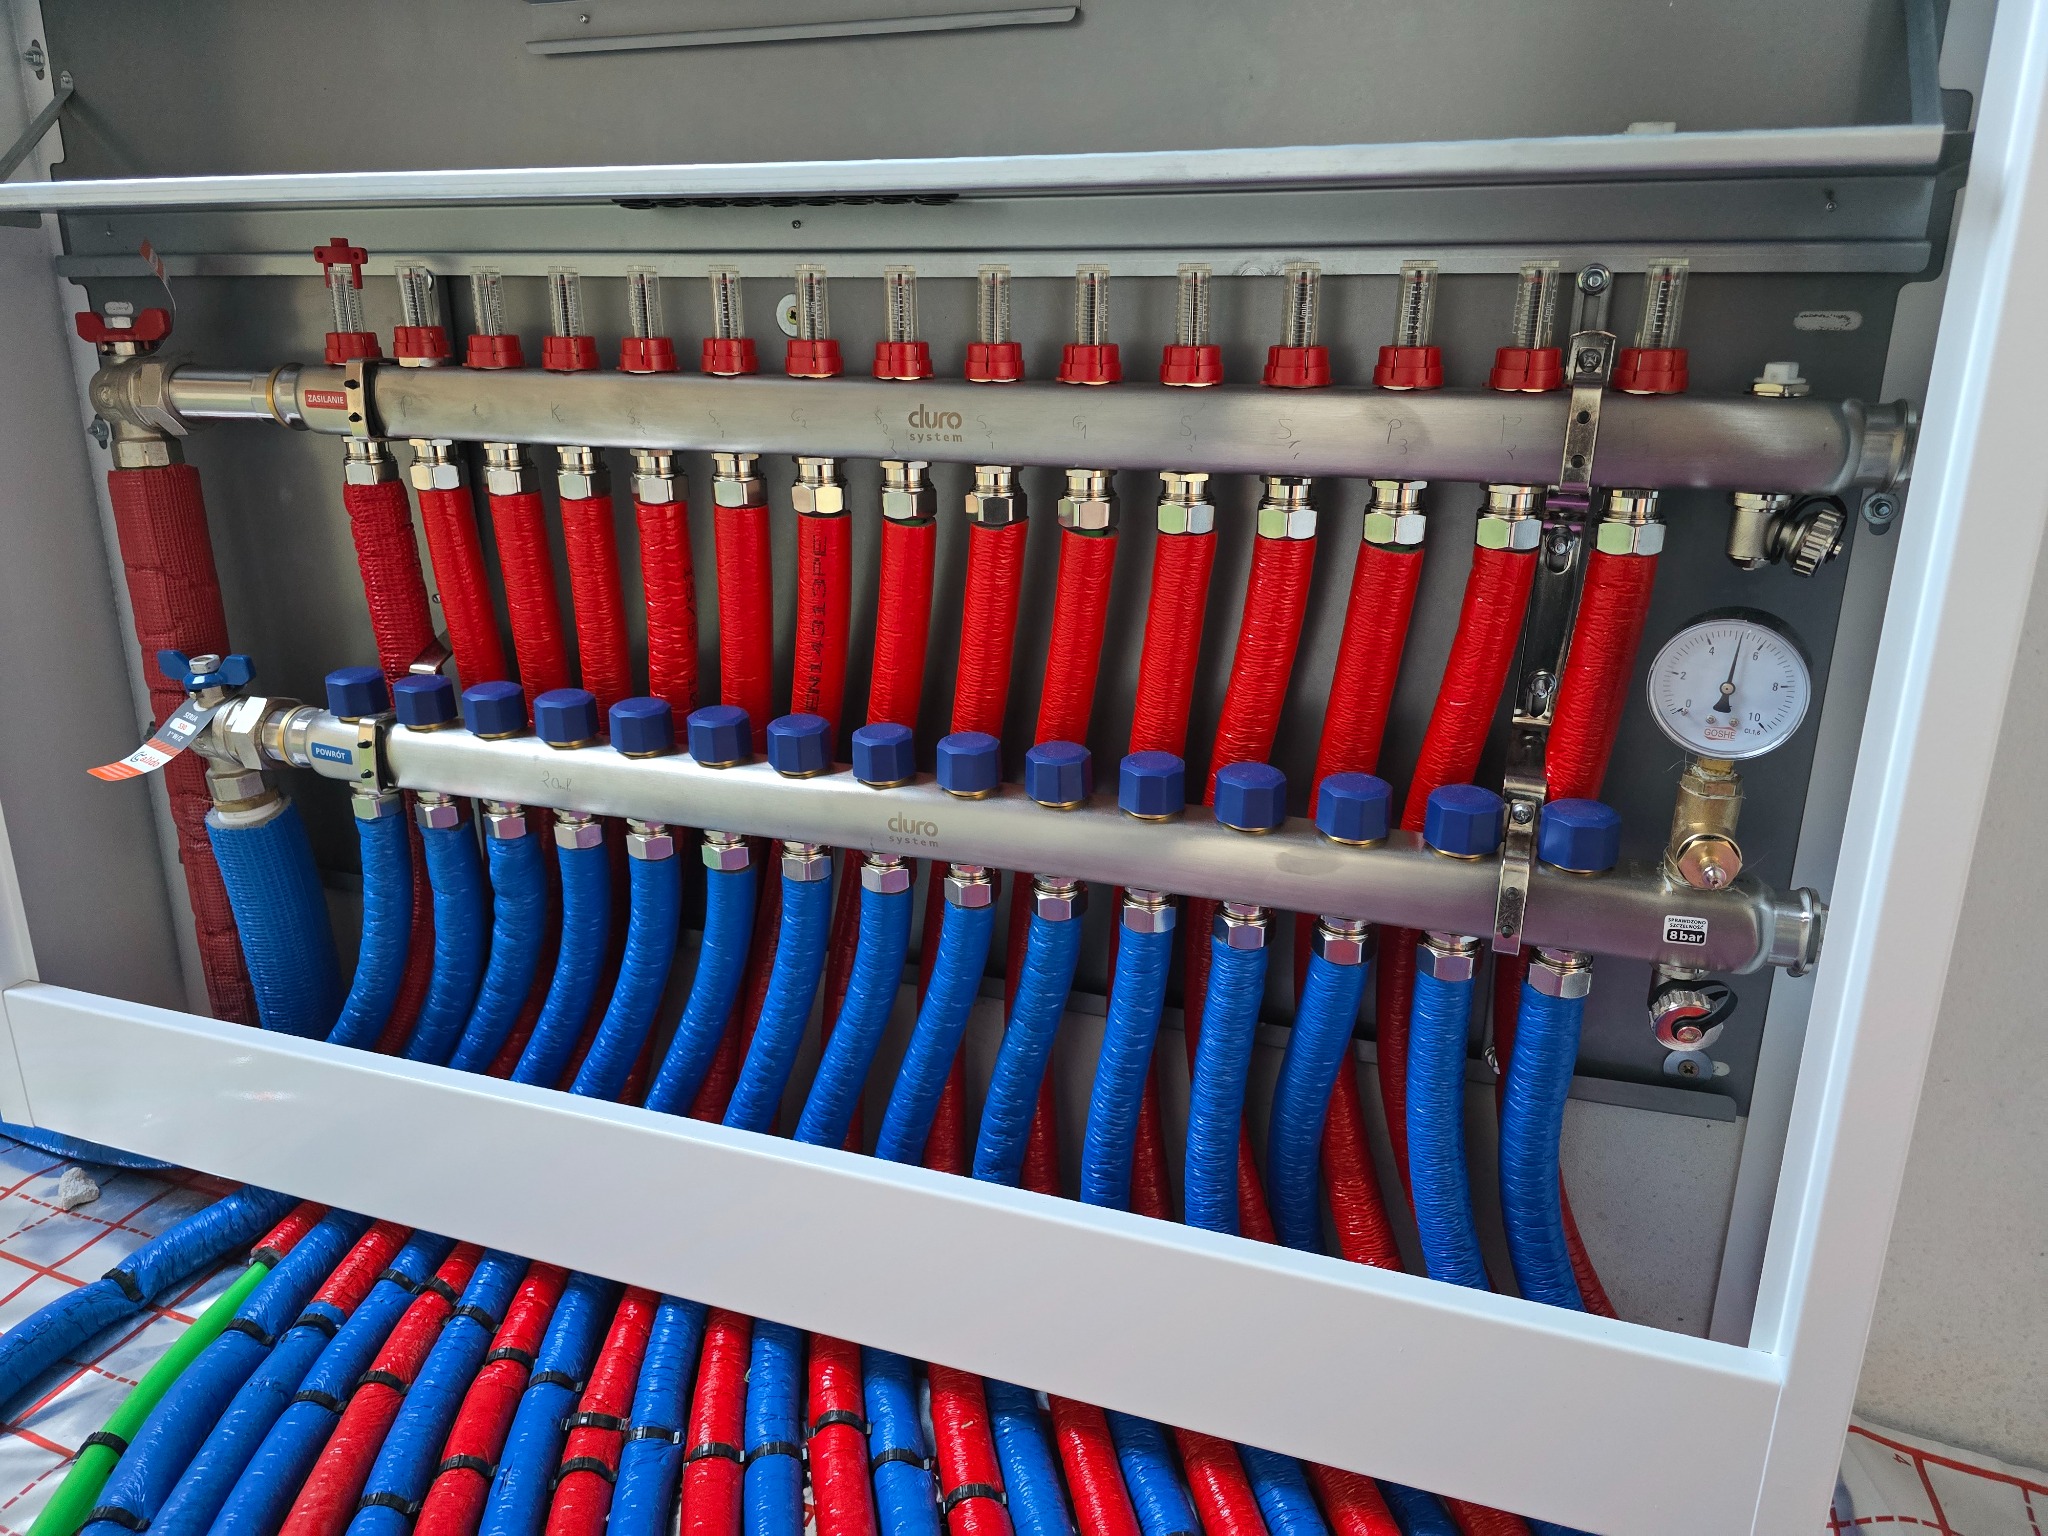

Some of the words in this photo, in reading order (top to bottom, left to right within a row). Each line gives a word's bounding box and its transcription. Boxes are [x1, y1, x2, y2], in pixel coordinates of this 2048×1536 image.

[307, 394, 345, 405] ZASILANIE
[908, 403, 963, 430] duro
[909, 432, 963, 443] system
[1708, 646, 1715, 655] 4
[1752, 652, 1759, 661] 6
[1680, 671, 1687, 680] 2
[1772, 682, 1778, 692] 8
[1685, 699, 1692, 708] 0
[1748, 712, 1761, 722] 10
[315, 747, 346, 760] POWRÓT
[887, 811, 939, 837] duro
[889, 835, 939, 848] system
[1670, 930, 1678, 940] 8
[1679, 930, 1702, 942] bar
